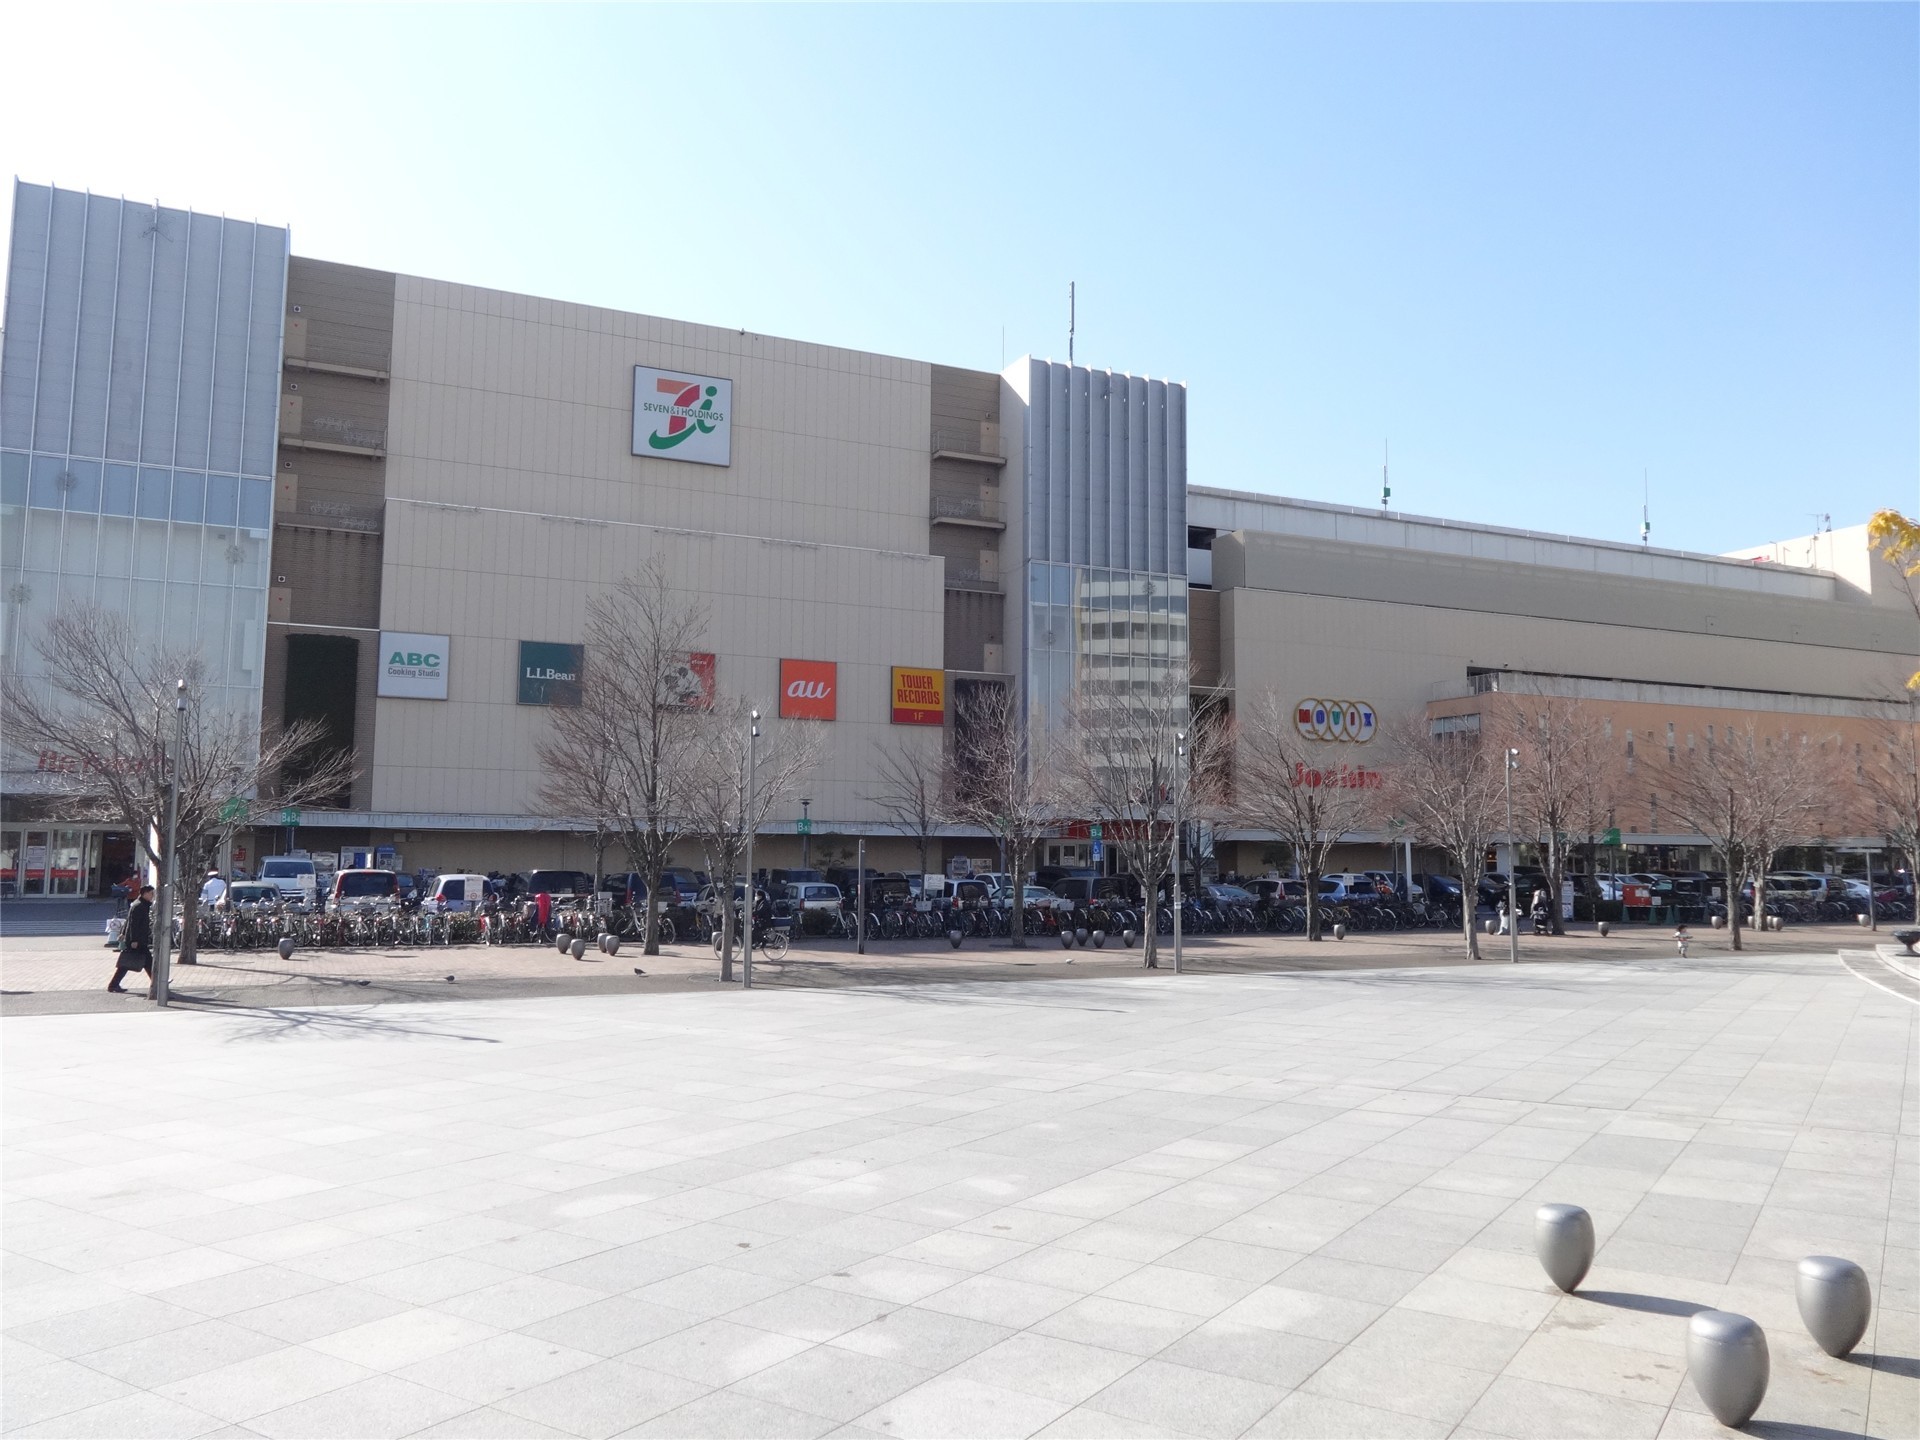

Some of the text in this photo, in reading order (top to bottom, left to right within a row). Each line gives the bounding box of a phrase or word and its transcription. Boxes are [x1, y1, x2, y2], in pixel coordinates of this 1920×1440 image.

[681, 408, 724, 422] HOLDINGS
[388, 651, 441, 668] ABC
[387, 667, 441, 678] Cooking Studio
[787, 680, 831, 699] au
[900, 674, 933, 689] TOWER
[897, 688, 941, 705] RECORDS
[912, 711, 924, 721] 1F
[1298, 708, 1373, 727] MOVIX
